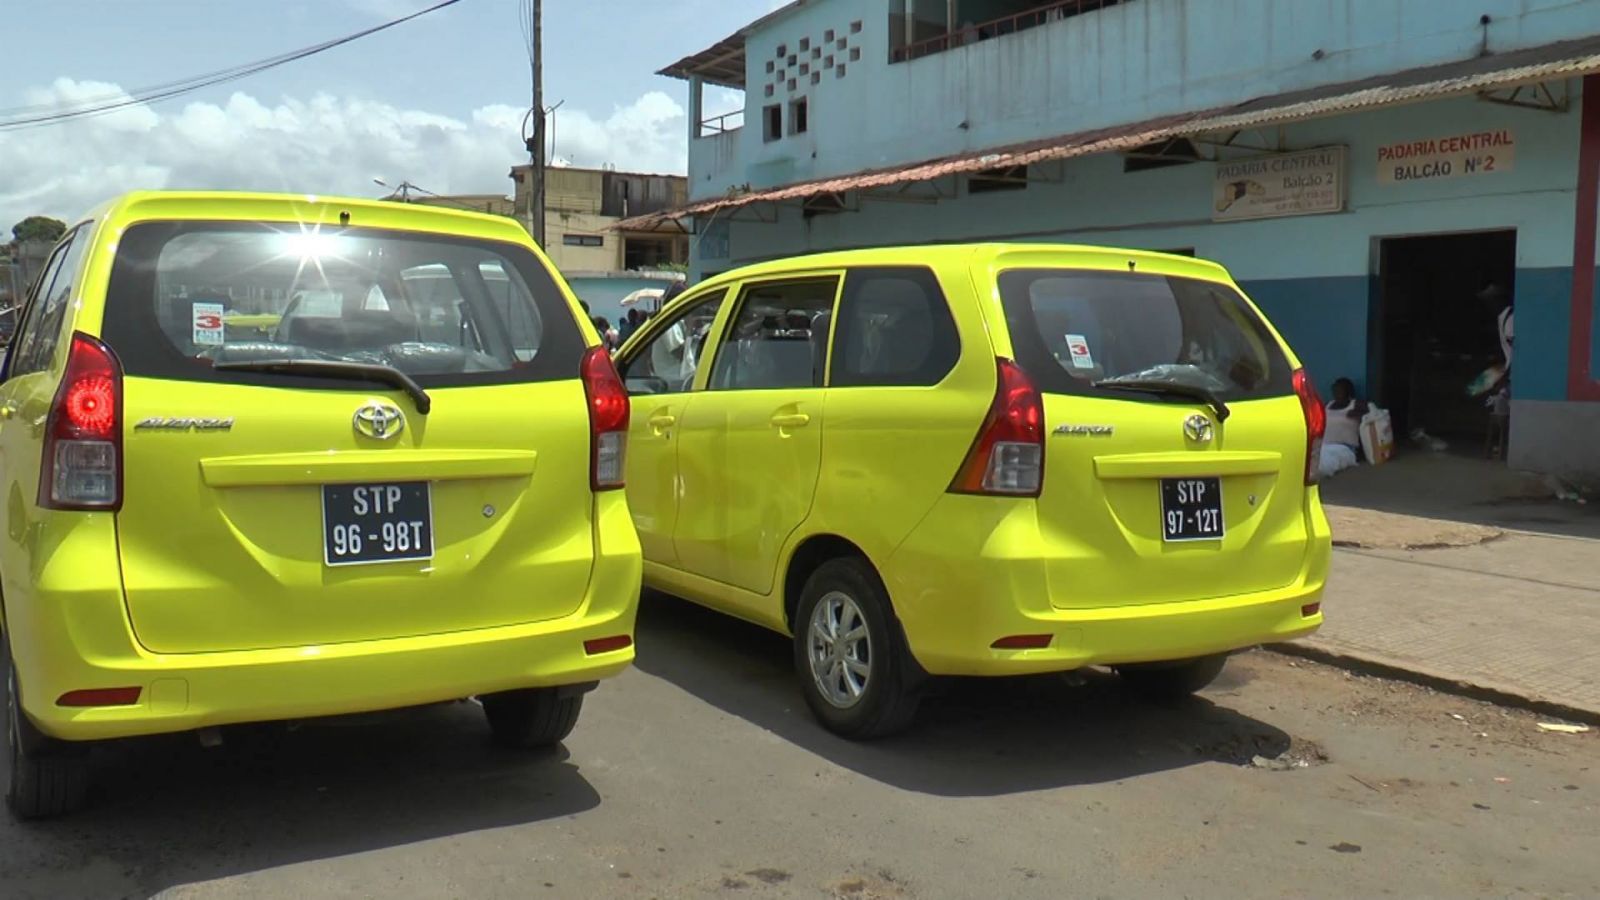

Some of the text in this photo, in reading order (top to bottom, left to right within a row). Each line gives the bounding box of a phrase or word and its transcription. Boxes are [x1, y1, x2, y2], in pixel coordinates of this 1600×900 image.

[1378, 130, 1513, 161] PADARIA CENTRAL
[1216, 154, 1335, 180] PADARIA CENTRAL
[1326, 172, 1334, 185] 2
[196, 315, 221, 328] 3
[353, 486, 401, 515] STP
[1177, 480, 1205, 503] STP
